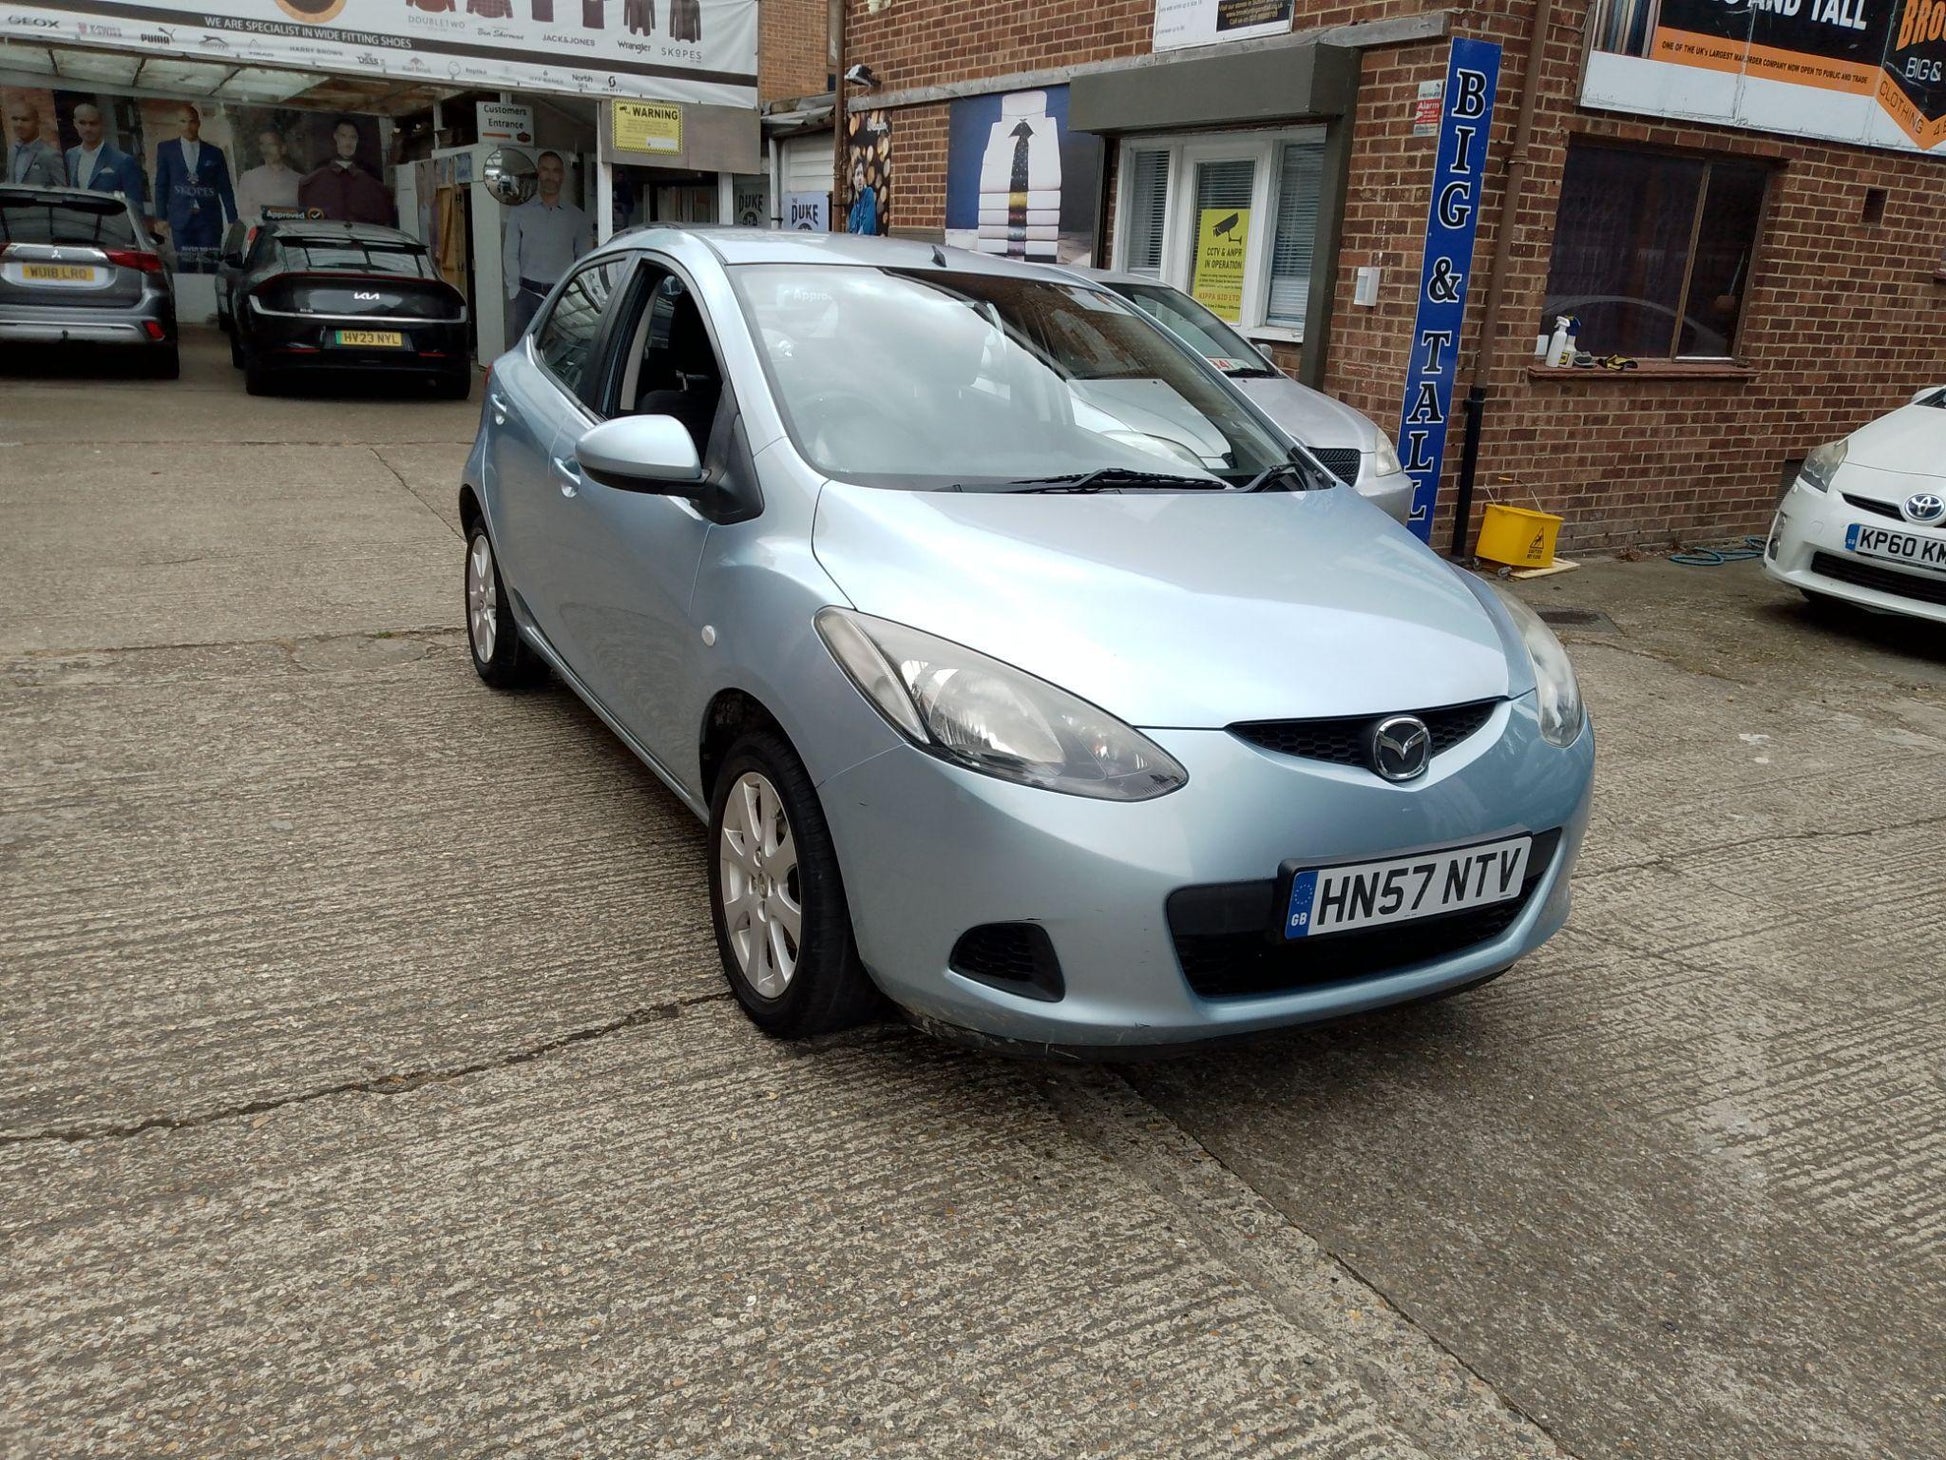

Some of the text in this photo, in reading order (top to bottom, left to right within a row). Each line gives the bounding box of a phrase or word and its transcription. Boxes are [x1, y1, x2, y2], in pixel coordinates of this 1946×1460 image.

[8, 15, 60, 29] GEOX
[1811, 0, 1867, 31] TALL
[204, 16, 412, 49] WE ARE SPECIALIST IN WIDE FITTING SHOES
[1896, 0, 1946, 52] BRO
[617, 40, 652, 54] Wrangler
[661, 47, 702, 60] SKOPES
[1662, 40, 1673, 51] ONE
[1675, 43, 1683, 52] OF
[1684, 45, 1695, 54] THE
[1709, 48, 1733, 60] LARGEST
[1763, 58, 1787, 71] COMPANY
[1787, 63, 1800, 73] NOW
[1800, 65, 1815, 75] OPEN
[1816, 68, 1823, 76] TO
[1823, 69, 1841, 80] PUBLIC
[483, 104, 528, 116] Customers
[632, 106, 678, 120] WARNING
[1417, 101, 1440, 110] Alarm
[1879, 80, 1924, 134] CLOTHING
[488, 118, 525, 130] Entrance
[738, 194, 764, 214] DUKE
[791, 204, 819, 226] DUKE
[1206, 247, 1220, 257] CCTV
[1204, 260, 1242, 270] IN OPERATION
[1403, 67, 1487, 521] BIG & TALL
[344, 334, 399, 344] HV23 NYL
[1859, 528, 1946, 565] KP60 KM
[1316, 847, 1522, 926] HN57 NTV
[1291, 911, 1308, 927] GB
